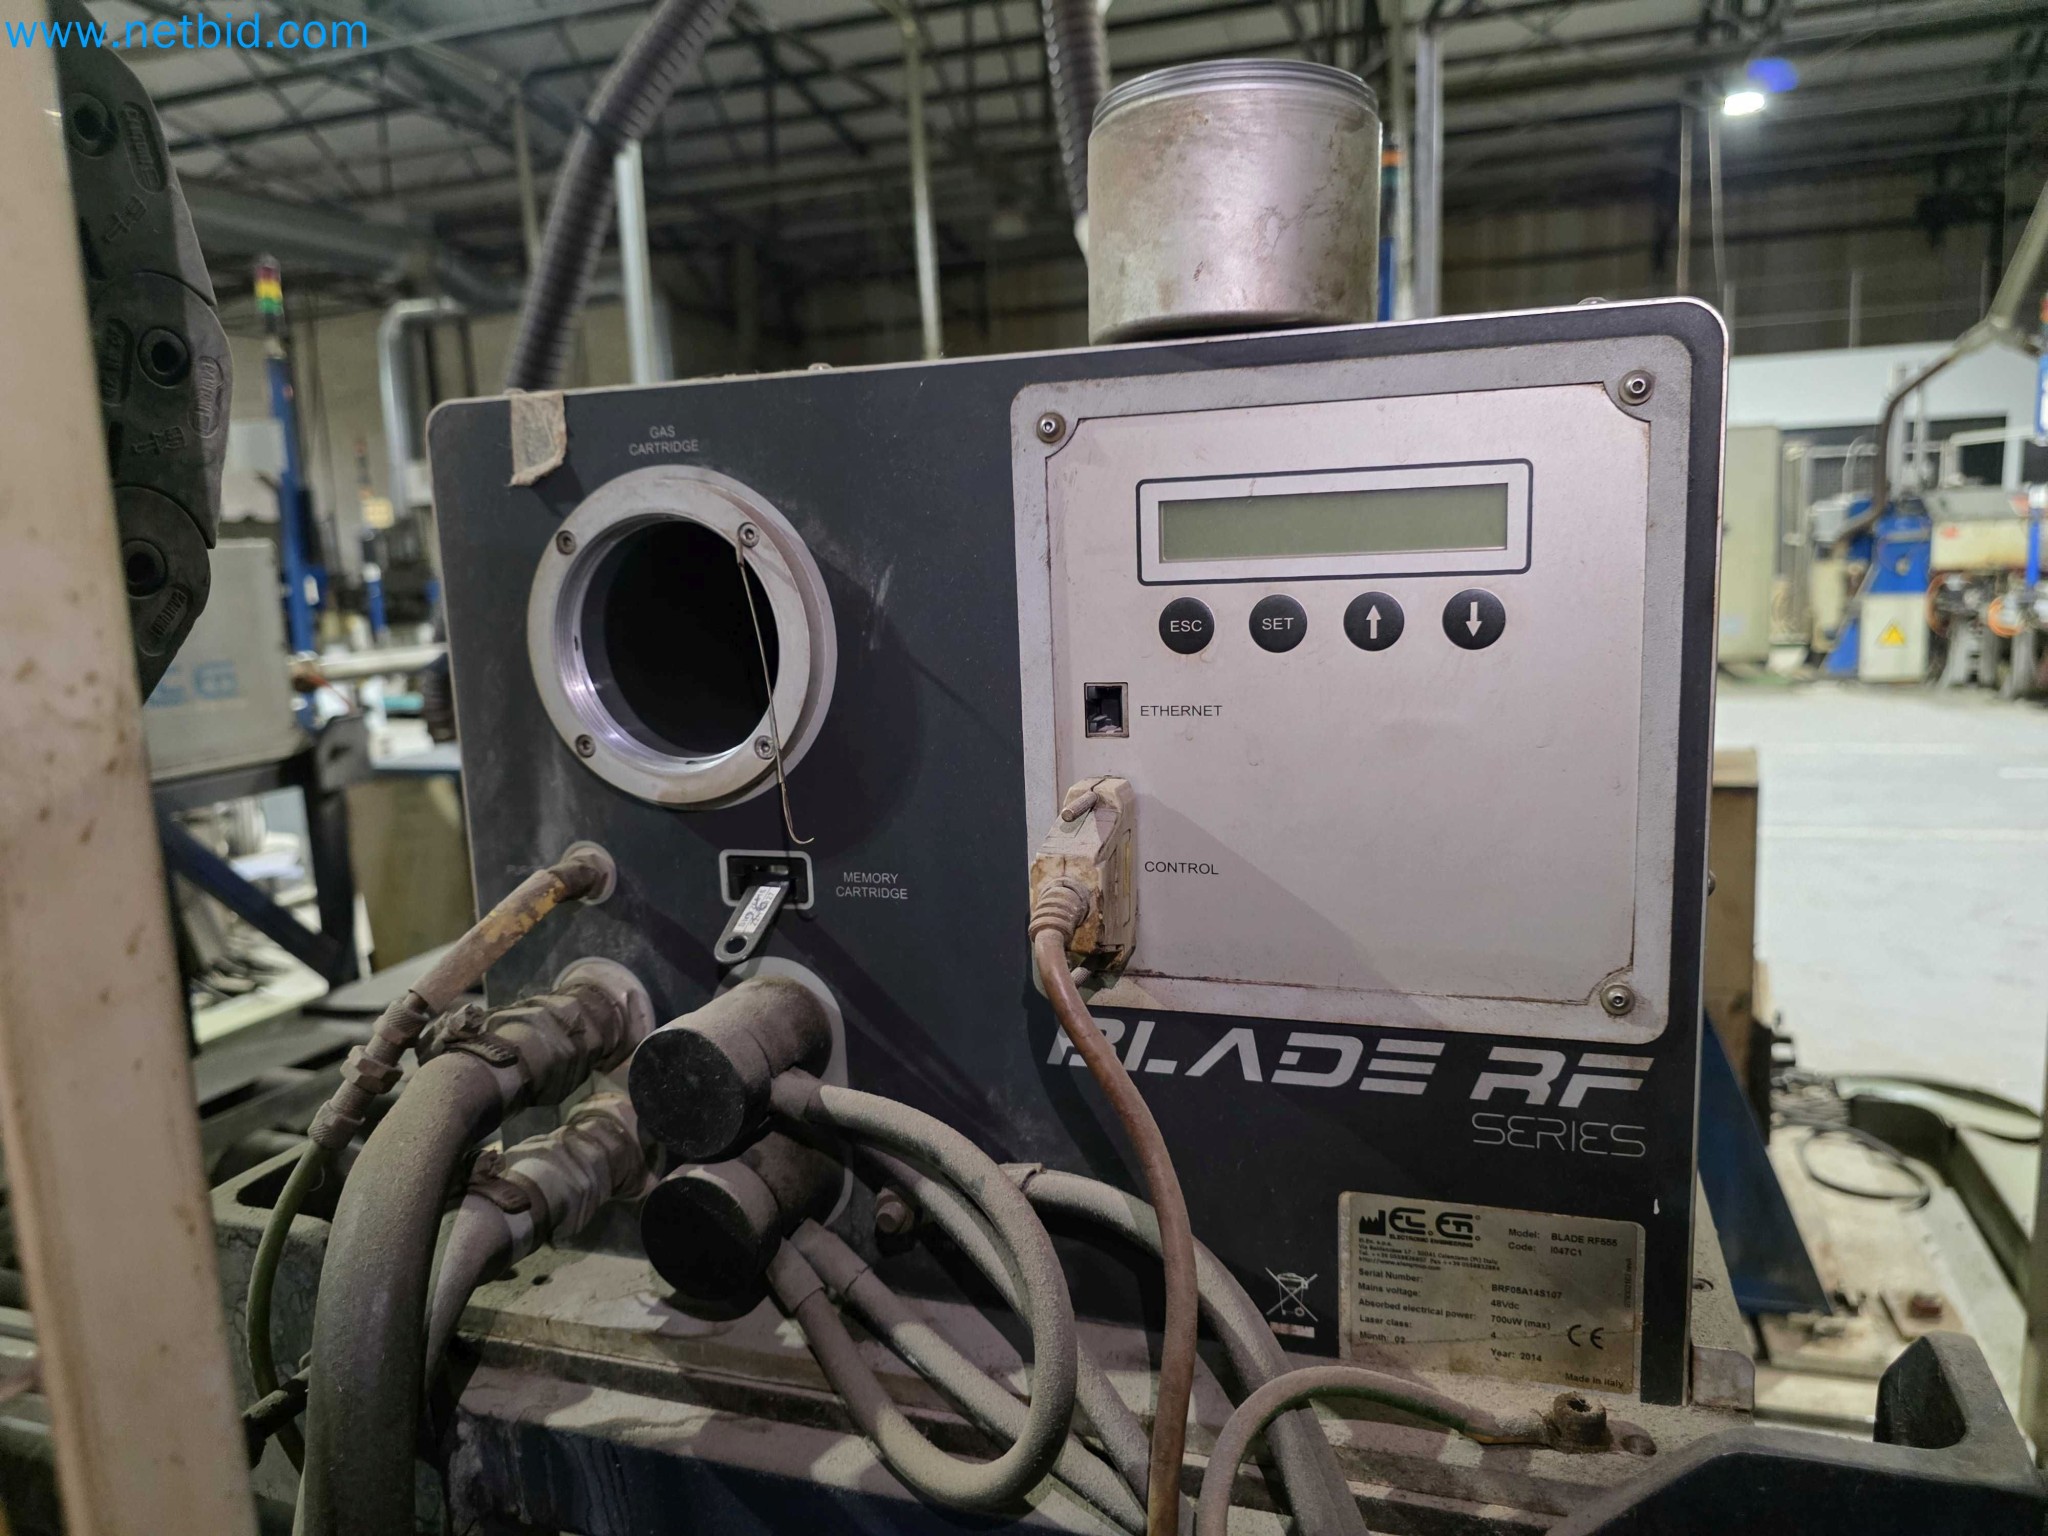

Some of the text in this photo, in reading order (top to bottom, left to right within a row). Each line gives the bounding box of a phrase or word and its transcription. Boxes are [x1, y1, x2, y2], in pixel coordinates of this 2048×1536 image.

[649, 425, 676, 439] GAS
[628, 439, 699, 456] CARTRIDGE
[1170, 617, 1294, 633] ESC SET
[1140, 705, 1223, 717] ETHERNET
[1144, 861, 1219, 875] CONTROL
[843, 872, 898, 884] MEMORY
[836, 886, 908, 899] CARTRIDGE
[1469, 1046, 1655, 1109] RF
[1472, 1112, 1647, 1158] SERIES
[1508, 1228, 1540, 1240] Model:
[1551, 1233, 1585, 1243] BLADE
[1508, 1242, 1536, 1252] Code:
[1359, 1269, 1383, 1278] Serial
[1385, 1271, 1423, 1282] Number:
[1358, 1282, 1520, 1310] Mains voltage: 48Vdc
[1358, 1298, 1401, 1310] Absorbed
[1403, 1305, 1443, 1316] electrical
[1445, 1310, 1476, 1320] power:
[1524, 1319, 1551, 1330] (max)
[1360, 1315, 1383, 1324] Laser
[1386, 1318, 1412, 1328] class:
[1490, 1348, 1515, 1359] Year:
[1520, 1352, 1543, 1362] 2014
[1565, 1373, 1590, 1383] Made
